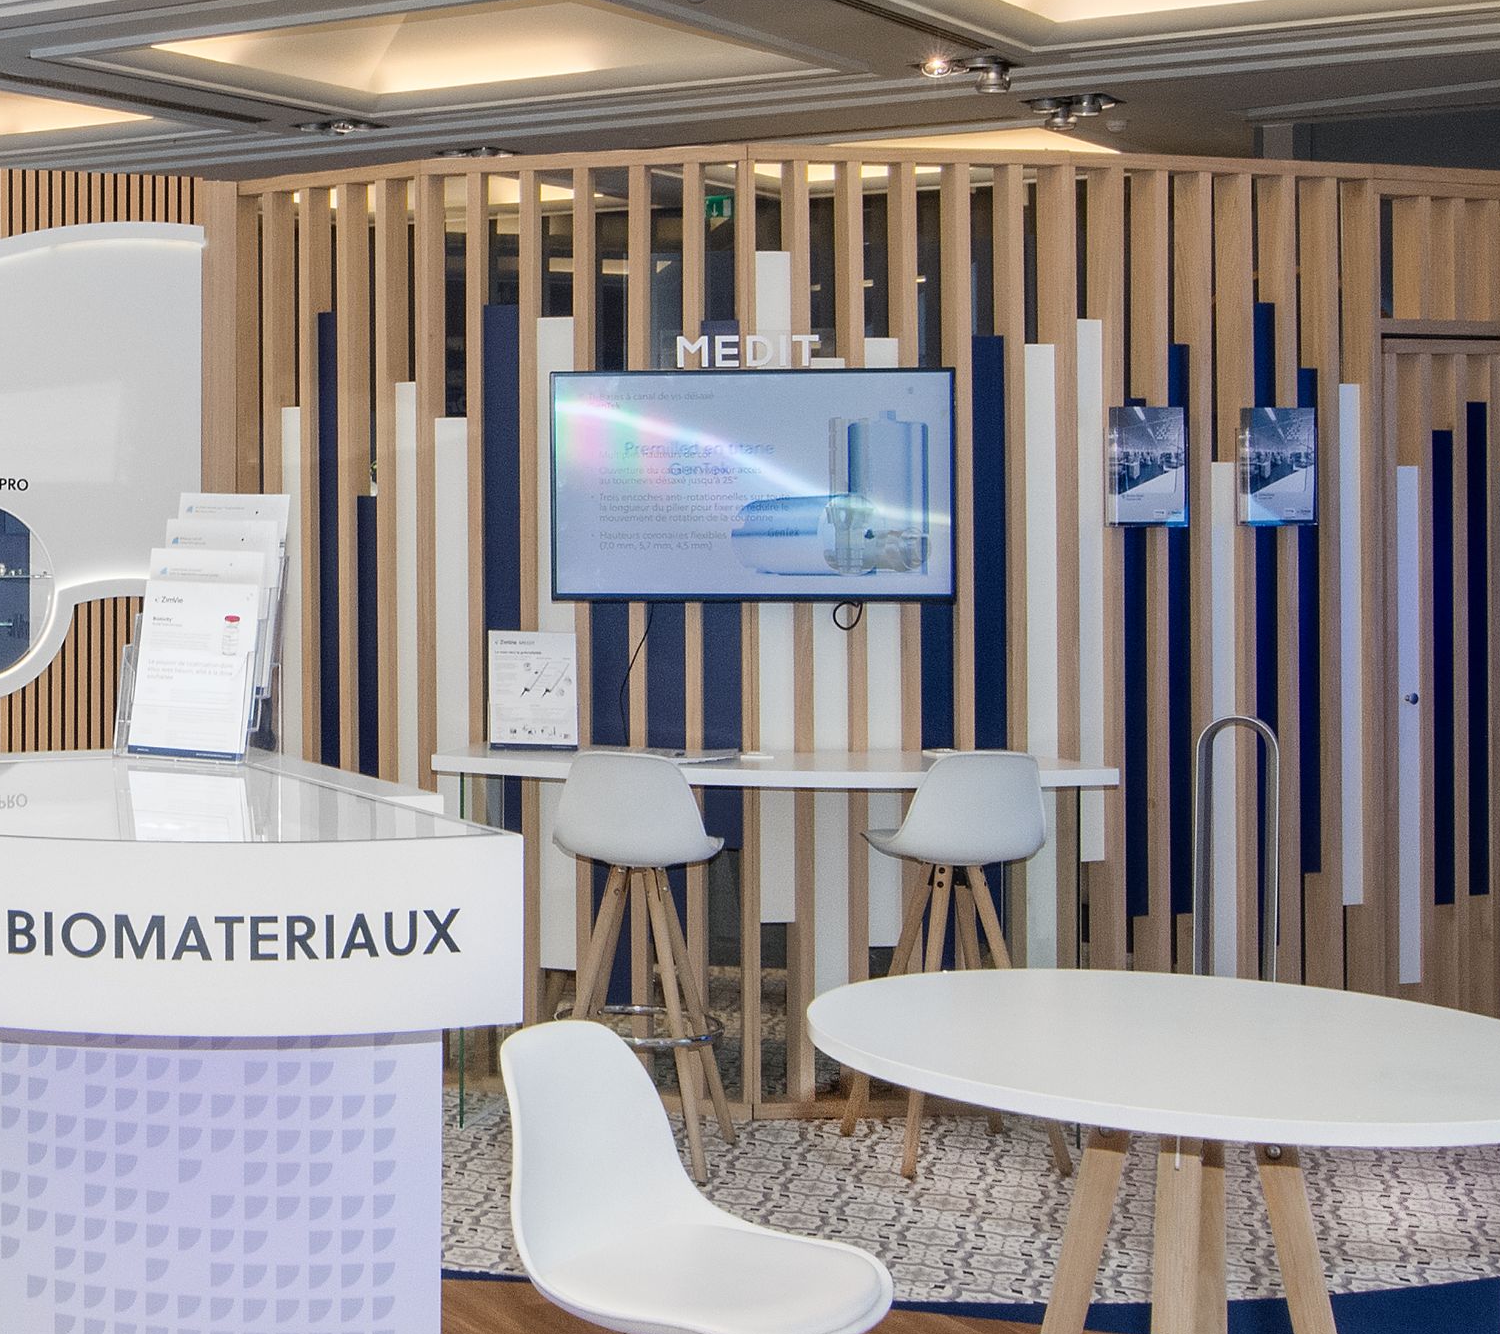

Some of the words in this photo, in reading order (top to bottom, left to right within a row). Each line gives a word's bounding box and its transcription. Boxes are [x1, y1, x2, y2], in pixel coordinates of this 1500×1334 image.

[676, 334, 820, 367] MEDIT
[0, 478, 29, 491] PRO
[609, 503, 650, 514] longueur
[651, 503, 664, 512] du
[655, 514, 667, 523] de
[599, 531, 640, 540] Hauteurs
[7, 908, 461, 961] BIOMATERIAUX
